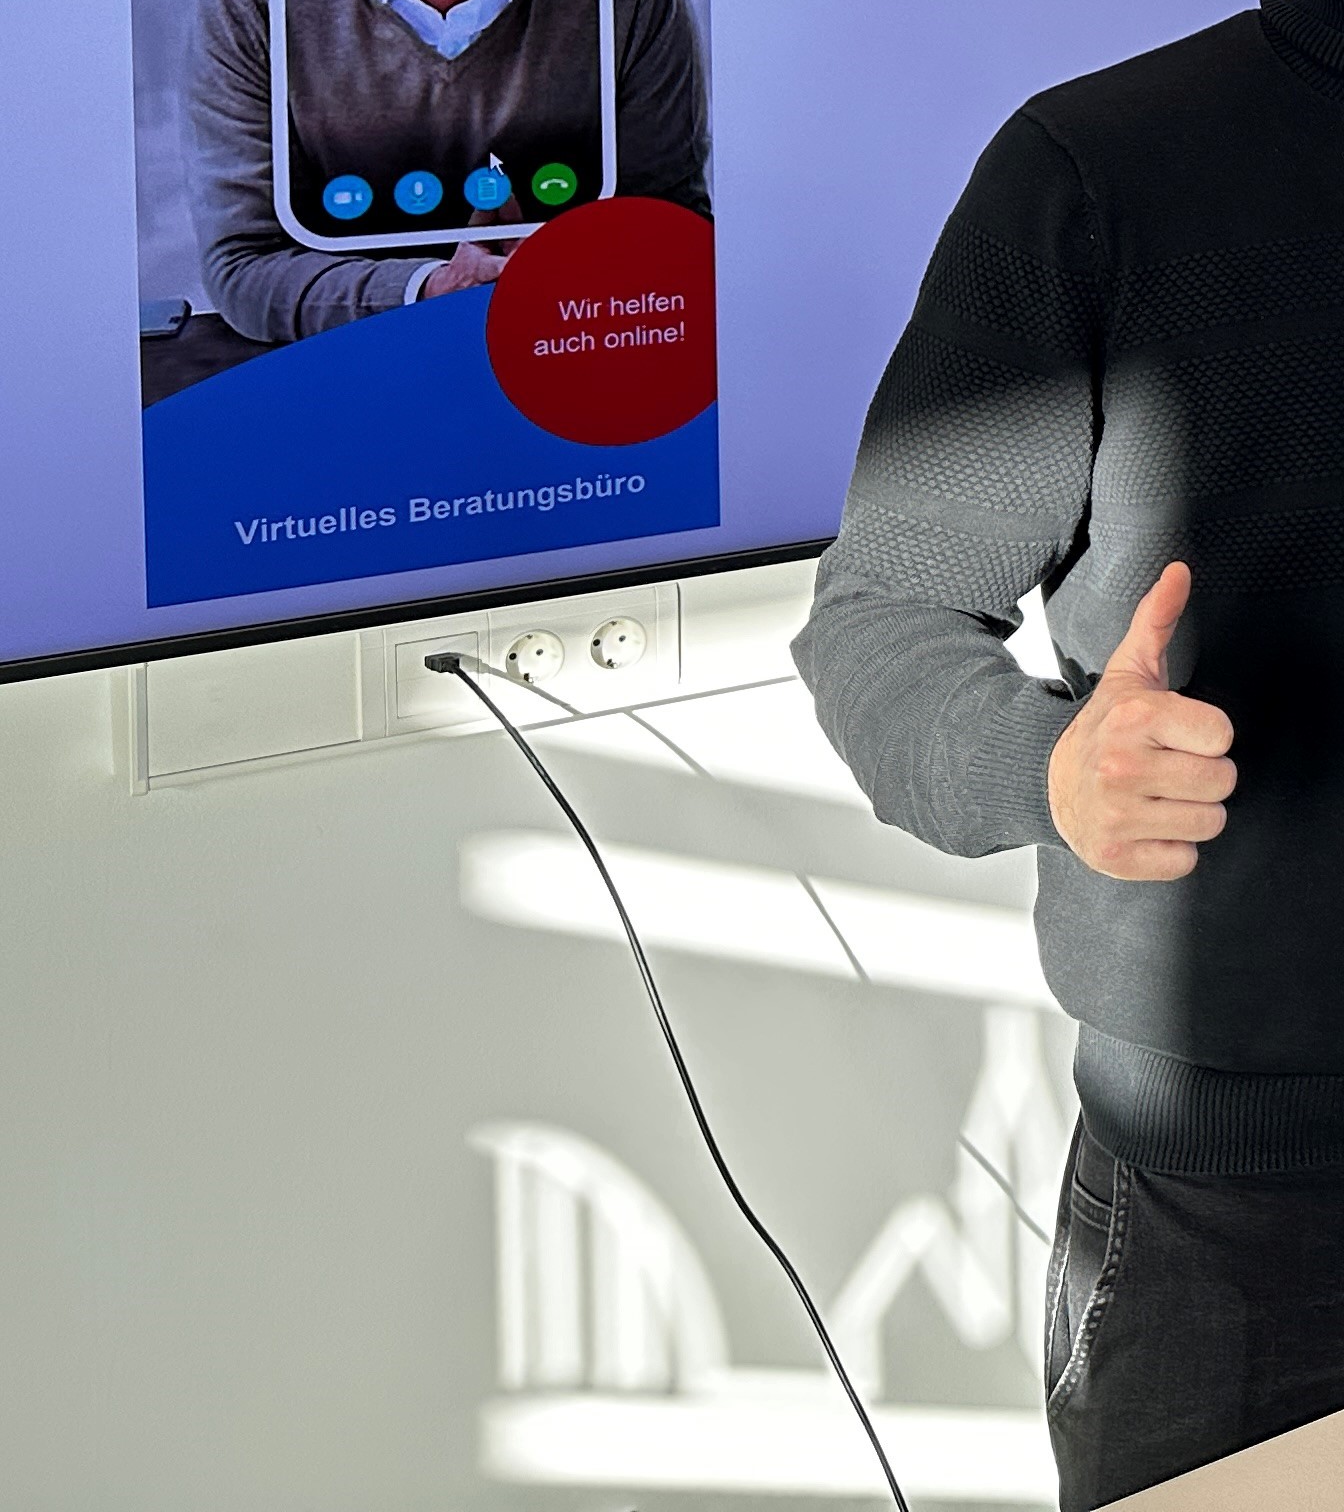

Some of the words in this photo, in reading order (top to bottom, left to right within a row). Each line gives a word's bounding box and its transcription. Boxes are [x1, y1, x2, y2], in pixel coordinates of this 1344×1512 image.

[557, 296, 603, 322] Wir
[607, 291, 686, 318] helfen
[532, 328, 597, 357] auch
[602, 321, 687, 351] online!
[233, 502, 398, 546] Virtuelles
[408, 471, 647, 525] Beratungsbüro
